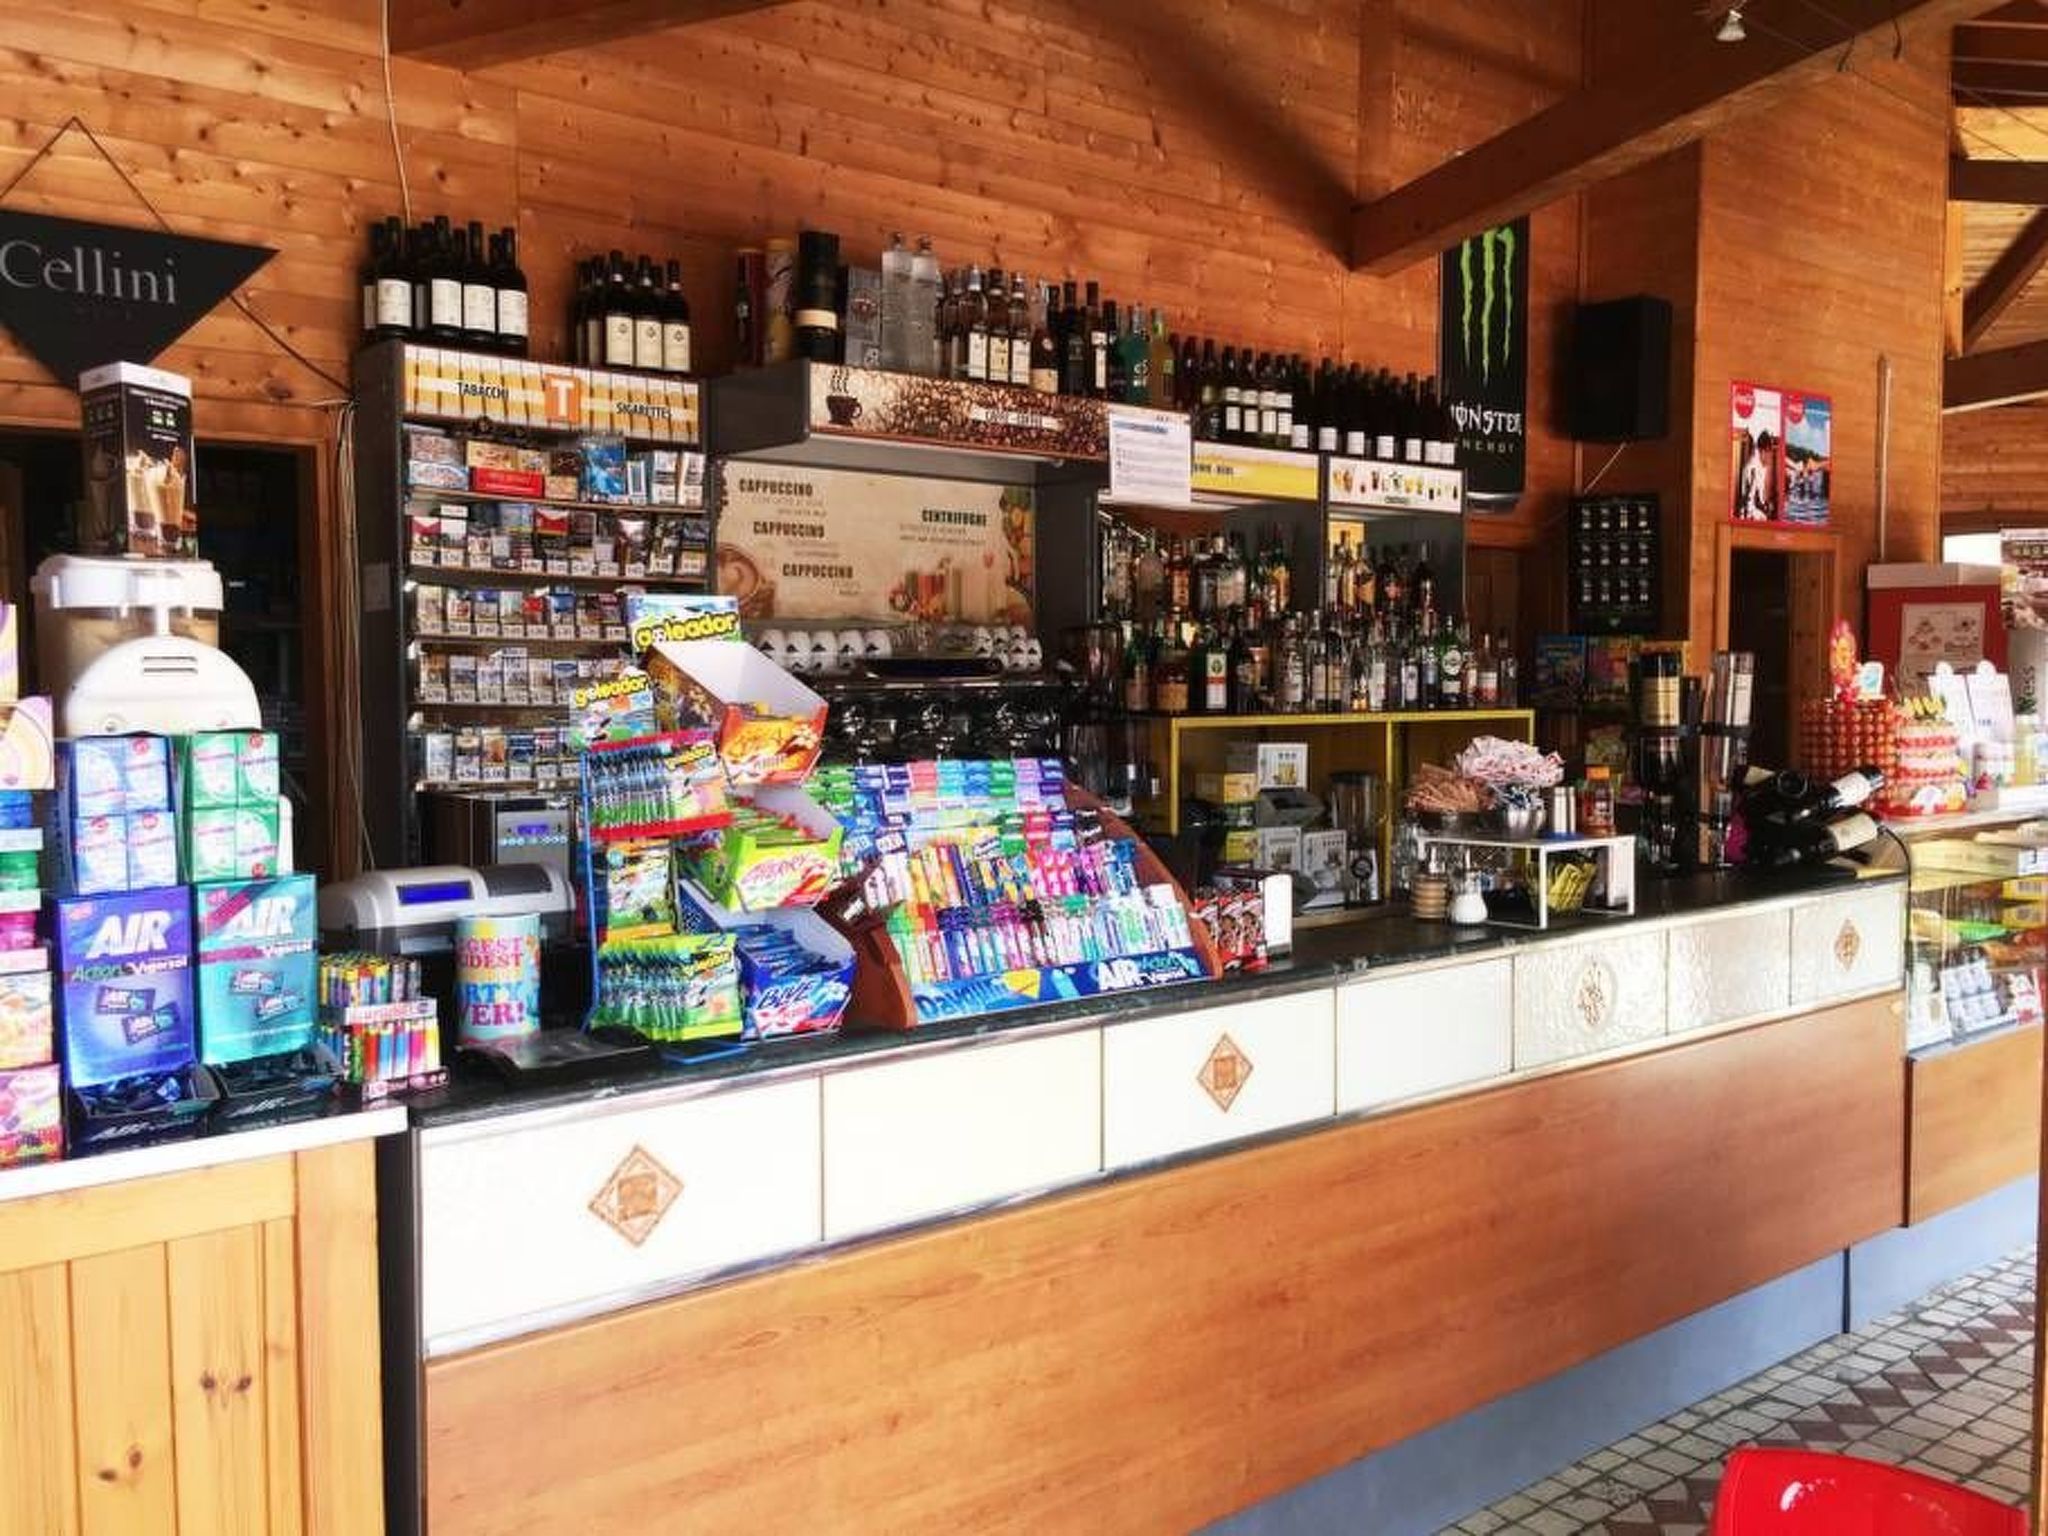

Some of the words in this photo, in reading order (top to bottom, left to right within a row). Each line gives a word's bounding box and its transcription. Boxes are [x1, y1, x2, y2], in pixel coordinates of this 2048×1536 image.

[0, 239, 177, 304] Cellini
[457, 382, 509, 400] TABACCHI
[551, 379, 575, 418] T
[739, 478, 813, 497] CAPPUCCINO
[753, 521, 825, 539] CAPPUCCINO
[782, 563, 853, 579] CAPPUCCINO
[634, 611, 738, 654] goleador
[574, 673, 648, 708] goleador
[85, 910, 171, 959] AIR
[1098, 957, 1141, 991] AIR
